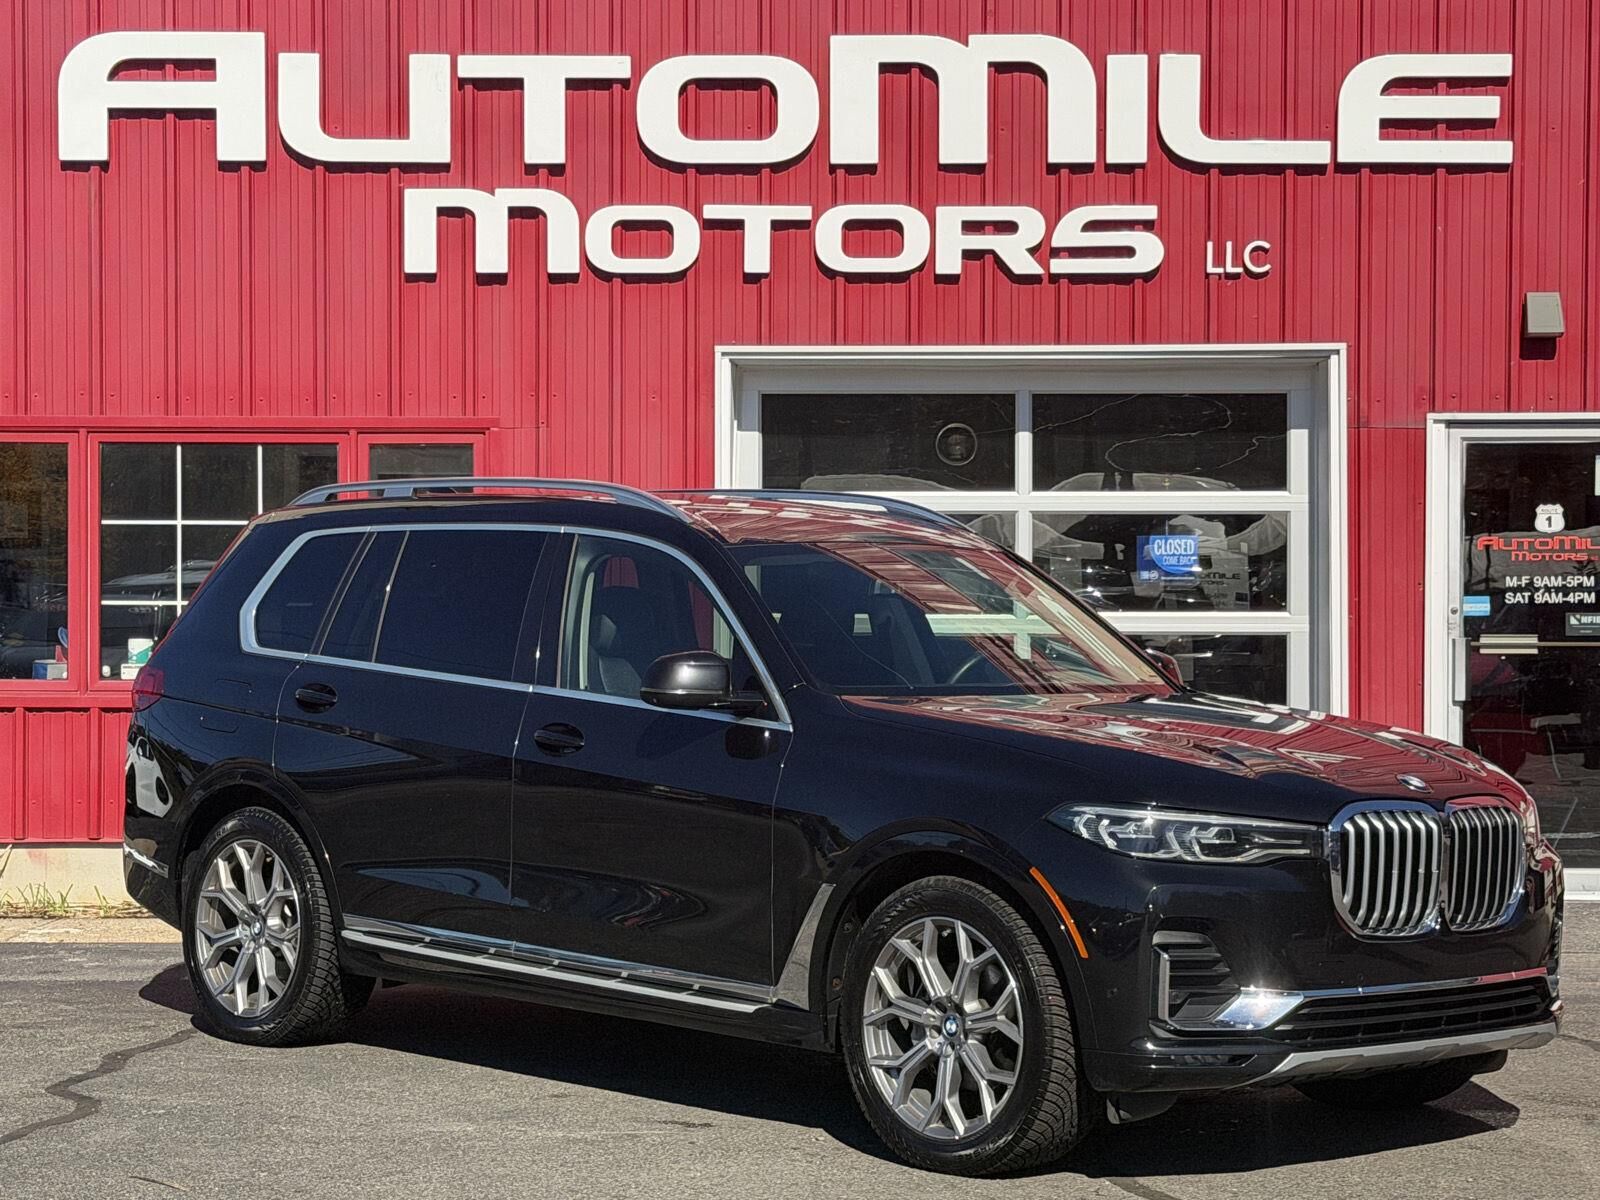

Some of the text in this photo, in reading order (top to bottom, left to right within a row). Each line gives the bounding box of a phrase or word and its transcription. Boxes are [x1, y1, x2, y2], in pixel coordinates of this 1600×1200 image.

[58, 31, 1513, 165] AUTOMILE
[404, 188, 1271, 277] MOTORS LLC
[1545, 515, 1552, 528] 1
[1153, 539, 1195, 555] CLOSED
[1477, 535, 1600, 550] AUTOMIL
[1511, 551, 1588, 561] MOTORS
[1505, 576, 1595, 588] M-F 9AM-5PM
[1505, 592, 1595, 604] SAT 9AM-4PM
